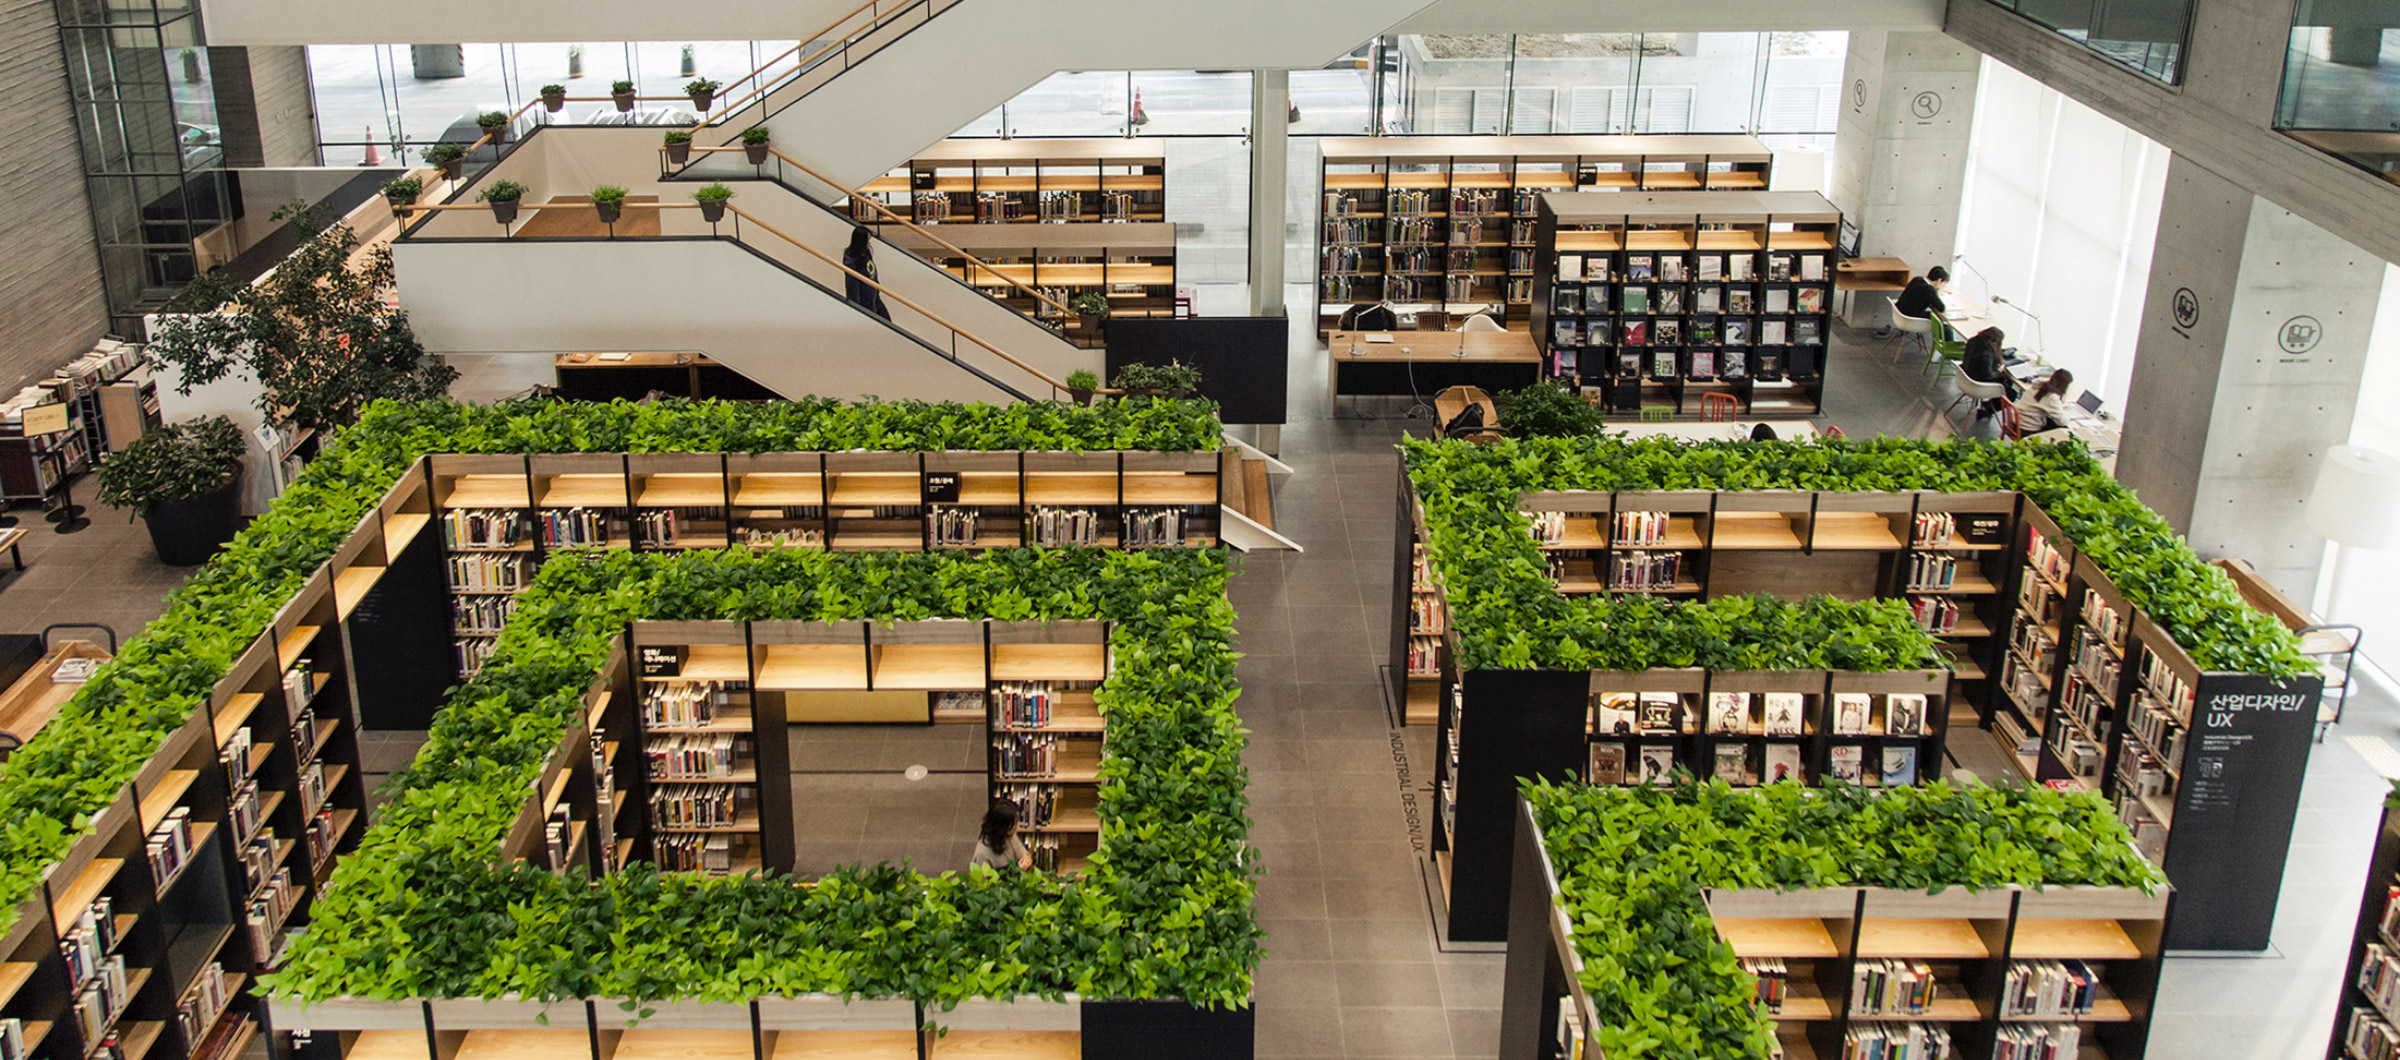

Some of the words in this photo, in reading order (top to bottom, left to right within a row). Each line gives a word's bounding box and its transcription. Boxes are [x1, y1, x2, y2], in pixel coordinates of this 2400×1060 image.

[2210, 695, 2305, 711] 산업디자인/
[2208, 713, 2233, 727] UX
[1389, 732, 1413, 791] INDUSTRIAL
[1401, 793, 1426, 853] DESIGN/UX
